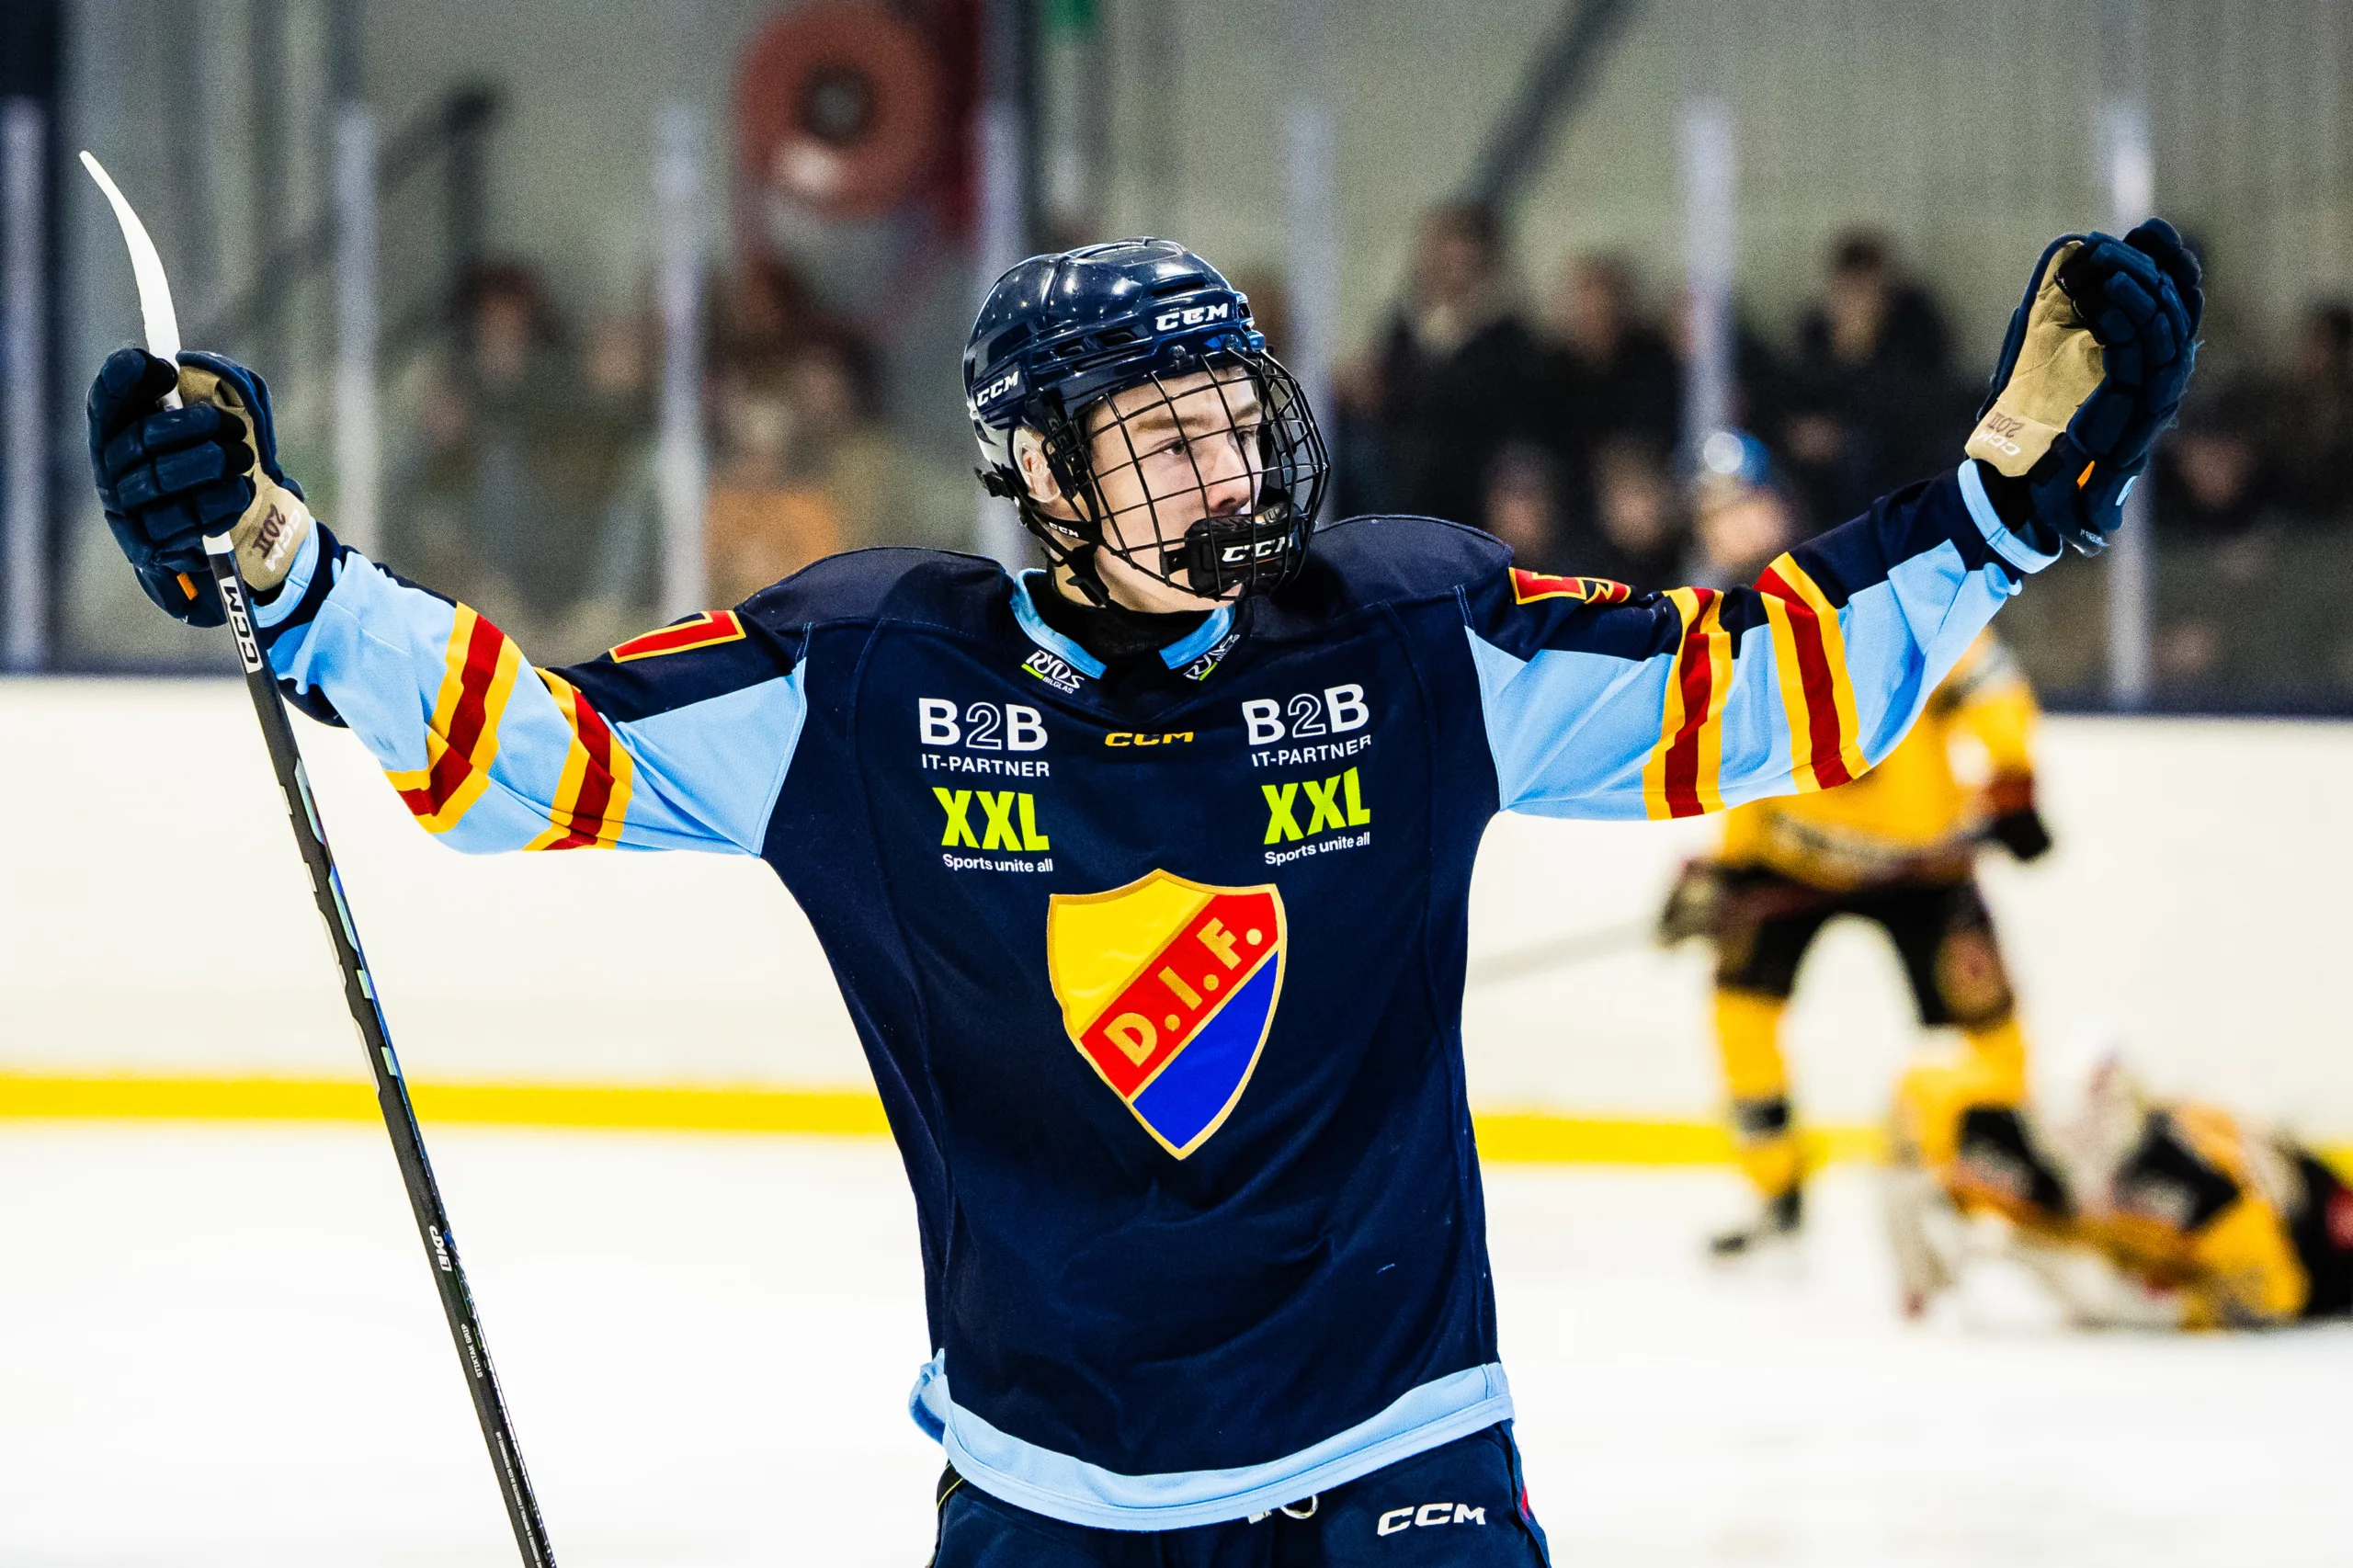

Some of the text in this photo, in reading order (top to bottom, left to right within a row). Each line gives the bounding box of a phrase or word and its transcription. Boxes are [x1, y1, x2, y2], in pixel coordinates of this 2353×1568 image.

[1155, 302, 1228, 331] CCM
[976, 370, 1019, 407] CCM
[1976, 429, 2021, 456] CCM
[265, 508, 301, 572] CCM
[1049, 522, 1079, 538] CCM
[224, 585, 259, 665] CCM
[1025, 649, 1085, 688] RYDS
[1042, 676, 1074, 695] BILGLAS
[918, 698, 1048, 751] B2B
[1242, 684, 1370, 745] B2B
[1105, 732, 1194, 746] CCM
[1251, 734, 1371, 767] IT-PARTNER
[921, 754, 1050, 777] IT-PARTNER
[932, 787, 1050, 851] XXL
[1261, 767, 1370, 845] XXL
[942, 853, 1053, 871] Sports unite all
[1265, 832, 1370, 866] Sports unite all
[1103, 917, 1263, 1068] D.I.F.
[460, 1323, 483, 1379] STIKTAK GRIP
[1378, 1503, 1485, 1537] CCM
